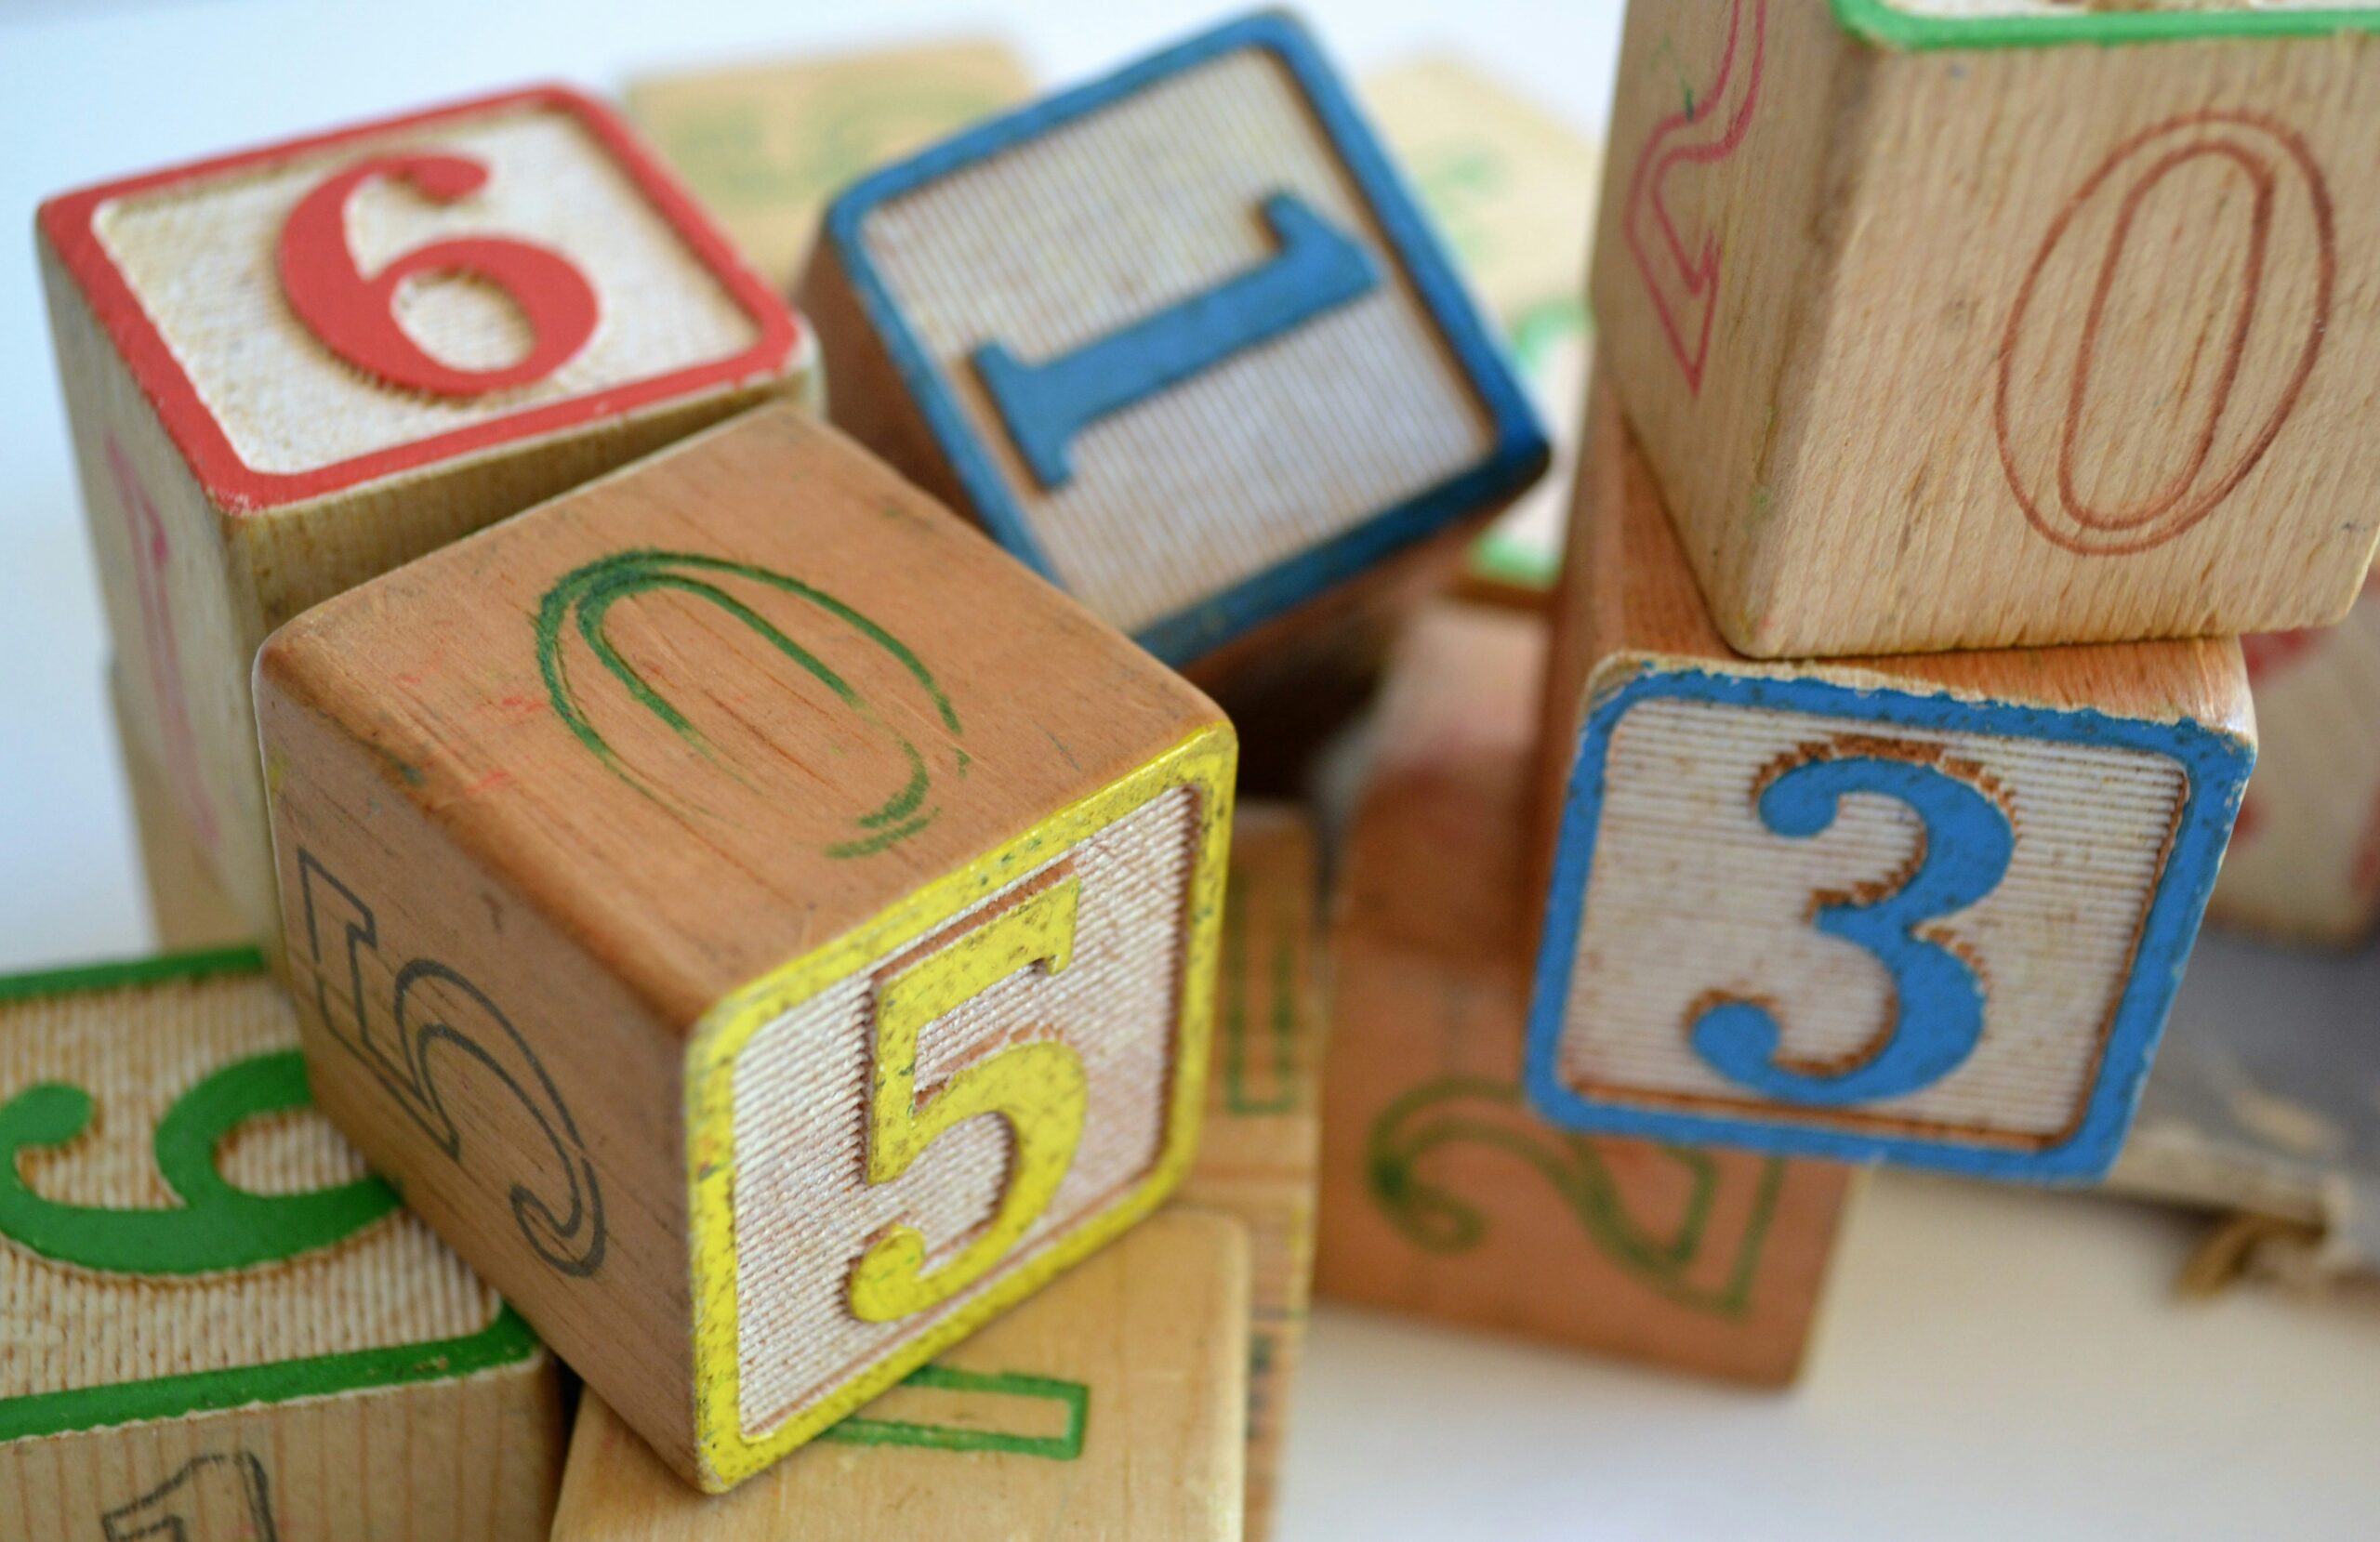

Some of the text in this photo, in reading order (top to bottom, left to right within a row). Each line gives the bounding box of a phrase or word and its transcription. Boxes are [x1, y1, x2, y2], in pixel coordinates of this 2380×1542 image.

[279, 152, 599, 397] 6
[970, 190, 1382, 489] 1
[1994, 109, 2336, 556] 0
[298, 848, 606, 1279] 5
[850, 877, 1088, 1324] 5
[1690, 757, 2015, 1108] 3
